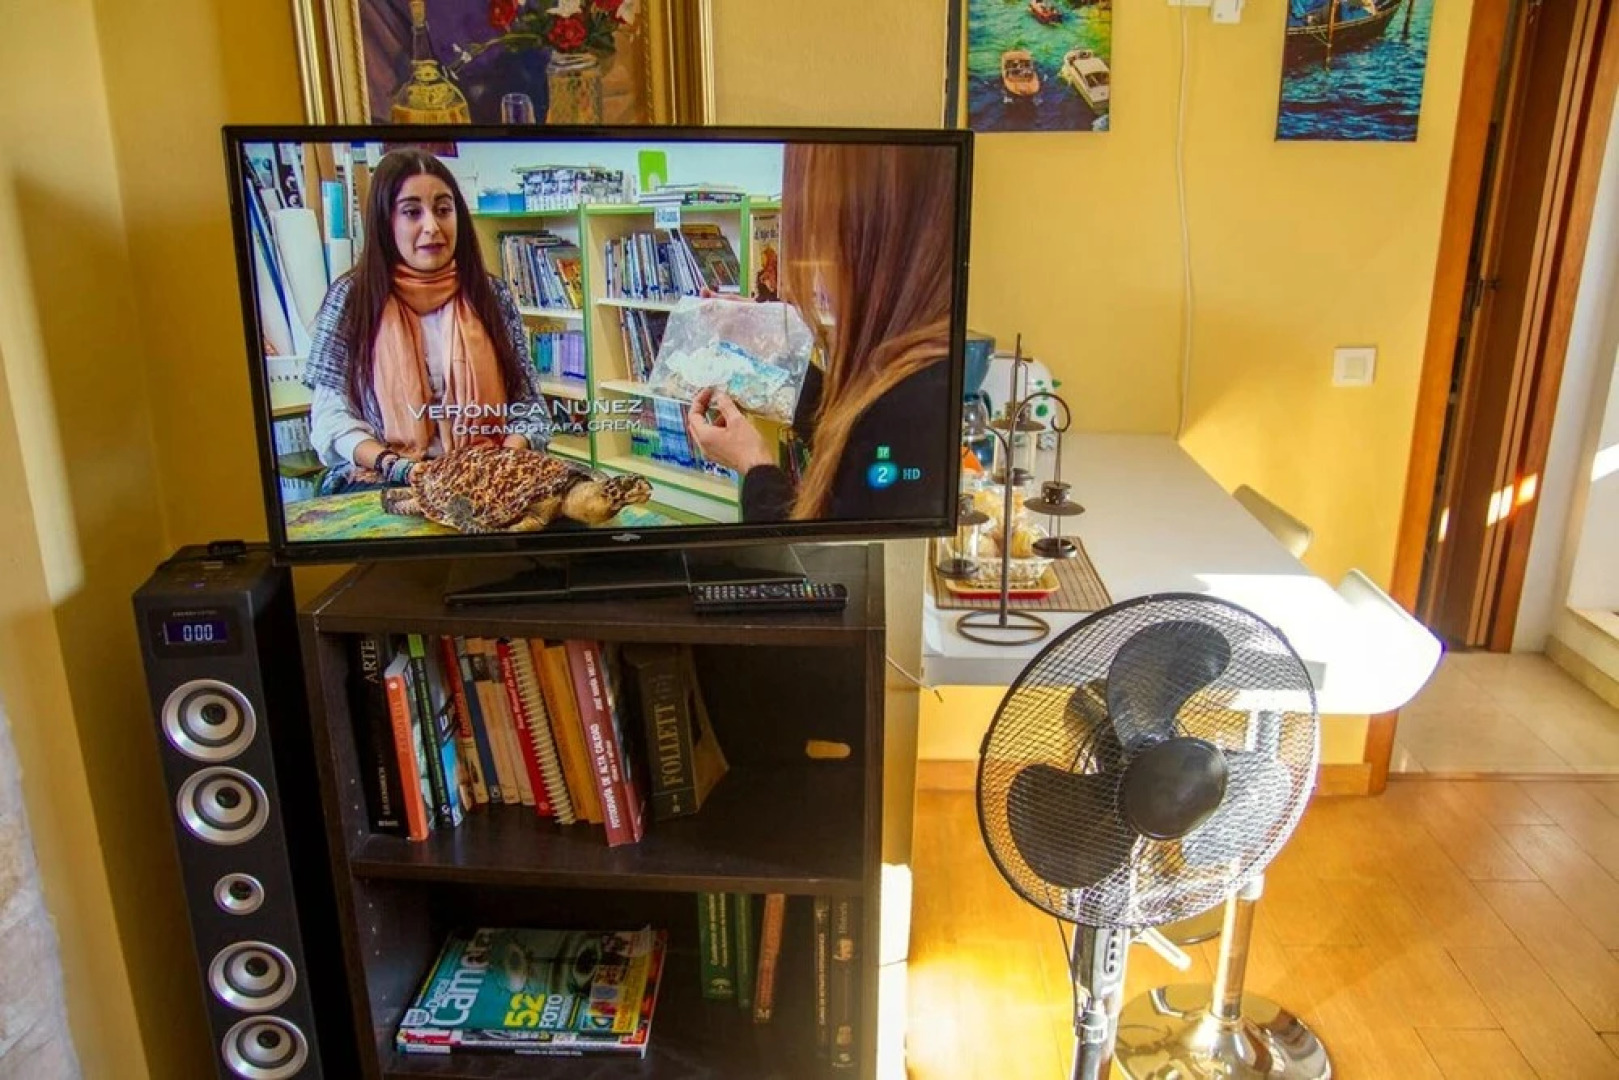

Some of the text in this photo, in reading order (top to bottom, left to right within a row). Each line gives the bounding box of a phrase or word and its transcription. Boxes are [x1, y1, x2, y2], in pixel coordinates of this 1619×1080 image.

[877, 466, 921, 484] 2 HD
[361, 640, 380, 684] ARTE
[653, 703, 684, 786] FOLLETT
[504, 993, 546, 1027] 52
[539, 995, 563, 1029] FOTO
